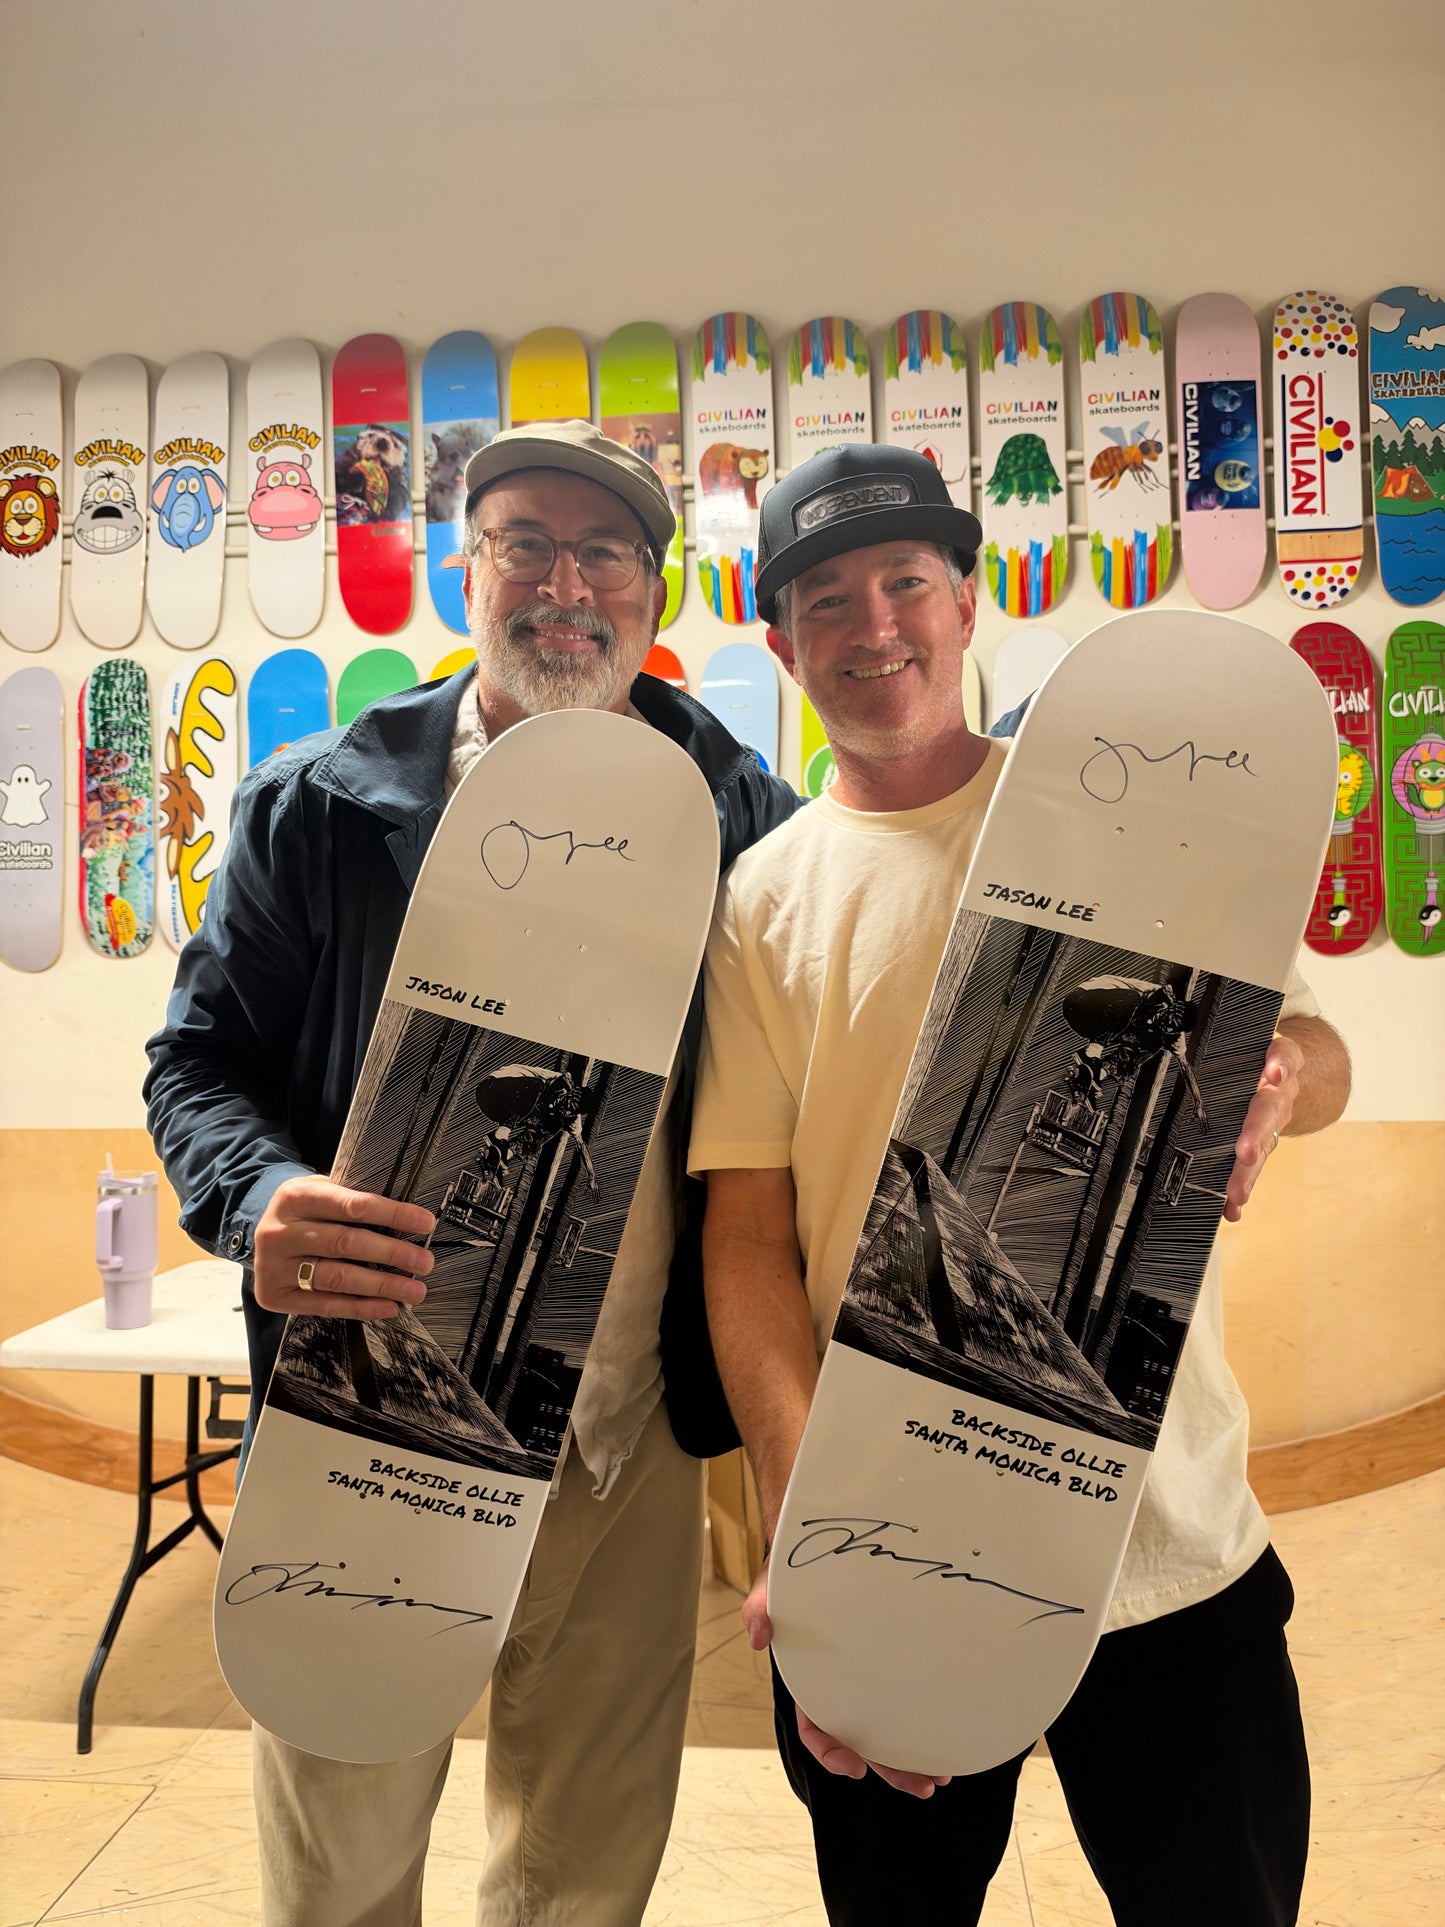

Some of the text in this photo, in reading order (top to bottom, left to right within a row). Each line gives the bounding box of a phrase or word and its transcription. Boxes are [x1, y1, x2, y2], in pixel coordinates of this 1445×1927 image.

[1087, 389, 1160, 405] CIVILIAN
[1373, 386, 1445, 399] SKATEBOARD
[697, 408, 767, 424] CIVILIAN
[795, 412, 865, 428] CIVILIAN
[891, 406, 962, 422] CIVILIAN
[986, 400, 1058, 415] CIVILIAN
[987, 414, 1058, 426] skateboards
[1089, 403, 1160, 415] skateboards
[248, 423, 321, 452] CIVILIAN
[698, 421, 766, 434] skateboards
[796, 425, 865, 438] skateboards
[892, 420, 962, 432] skateboards
[1185, 384, 1200, 480] CIVILIAN
[74, 439, 146, 467] CIVILIAN
[154, 438, 225, 465] CIVILIAN
[1288, 374, 1317, 515] CIVILIAN
[1327, 687, 1370, 715] LIAN
[1388, 686, 1445, 718] CIVILI
[0, 858, 53, 870] kateboards
[983, 883, 1094, 922] JASON LEE
[405, 976, 506, 1016] JASON LEE
[951, 1409, 1128, 1479] BACKSIDE OLLIE
[903, 1420, 1119, 1503] SANTA MONICA BLVD
[368, 1458, 525, 1507] BACKSIDE OLLIE
[327, 1470, 518, 1529] SANTA MONICA BLVD
